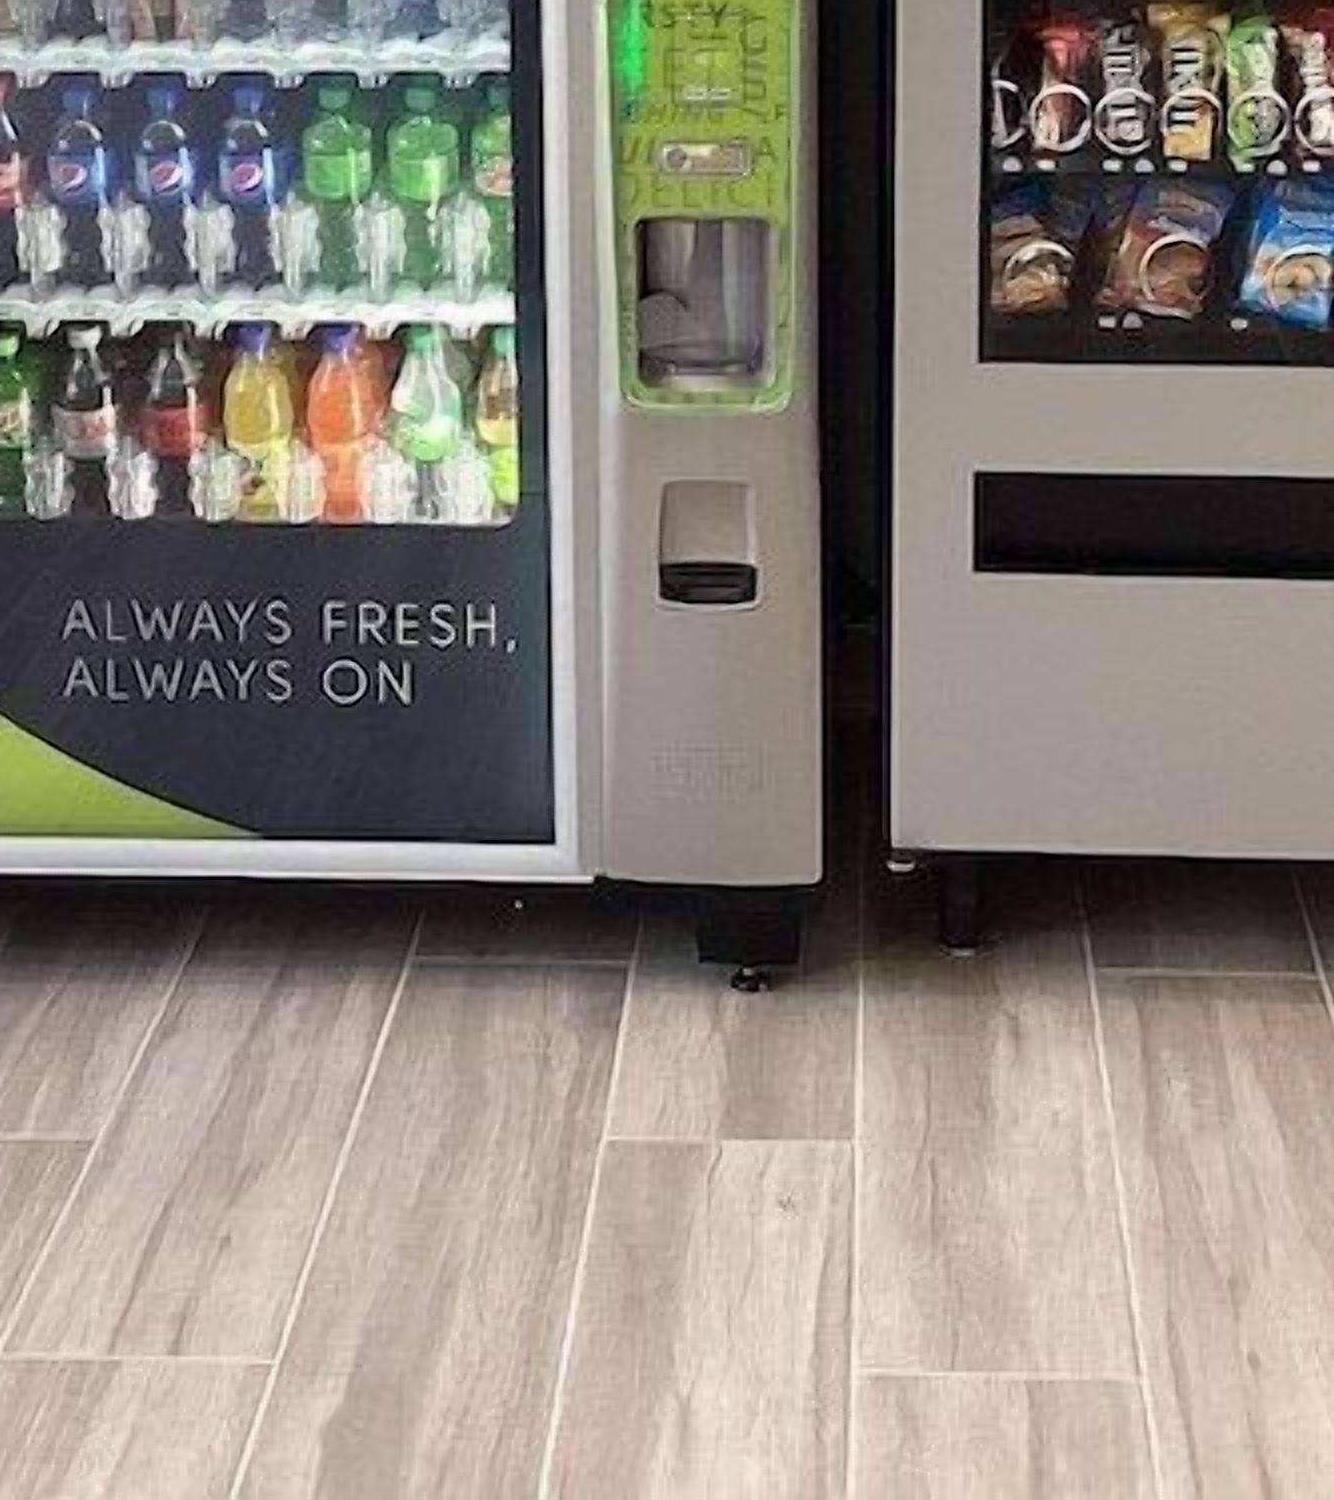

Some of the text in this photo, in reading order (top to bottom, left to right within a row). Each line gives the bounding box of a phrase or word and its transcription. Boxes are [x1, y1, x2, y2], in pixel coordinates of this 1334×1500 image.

[62, 598, 517, 653] ALWAYS FRESH,
[62, 657, 412, 704] ALWAYS ON
